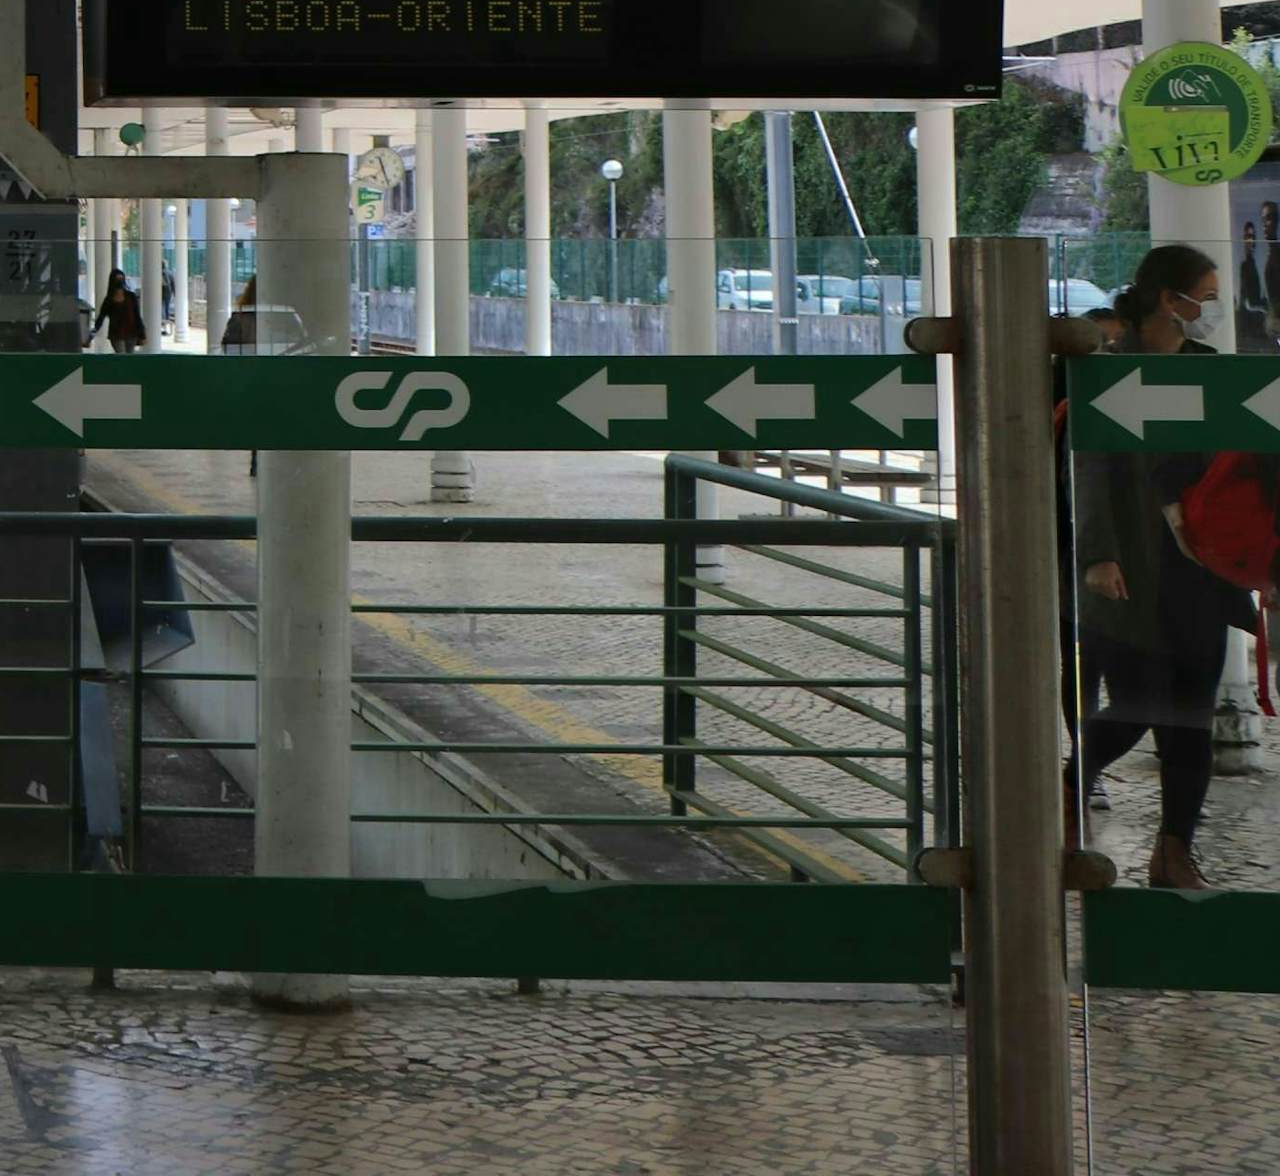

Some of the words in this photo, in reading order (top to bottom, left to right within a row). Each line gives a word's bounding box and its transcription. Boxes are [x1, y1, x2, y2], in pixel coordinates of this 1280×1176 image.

[185, 0, 602, 31] LISBOA-ORIENTE
[1160, 61, 1169, 69] O
[1171, 54, 1194, 66] SEU
[1199, 52, 1238, 76] TÍTULO
[1133, 69, 1161, 103] VALIDE
[1237, 74, 1252, 87] DE
[1237, 90, 1261, 158] TRANSPORTE
[364, 205, 376, 219] 3
[335, 371, 471, 441] CP
